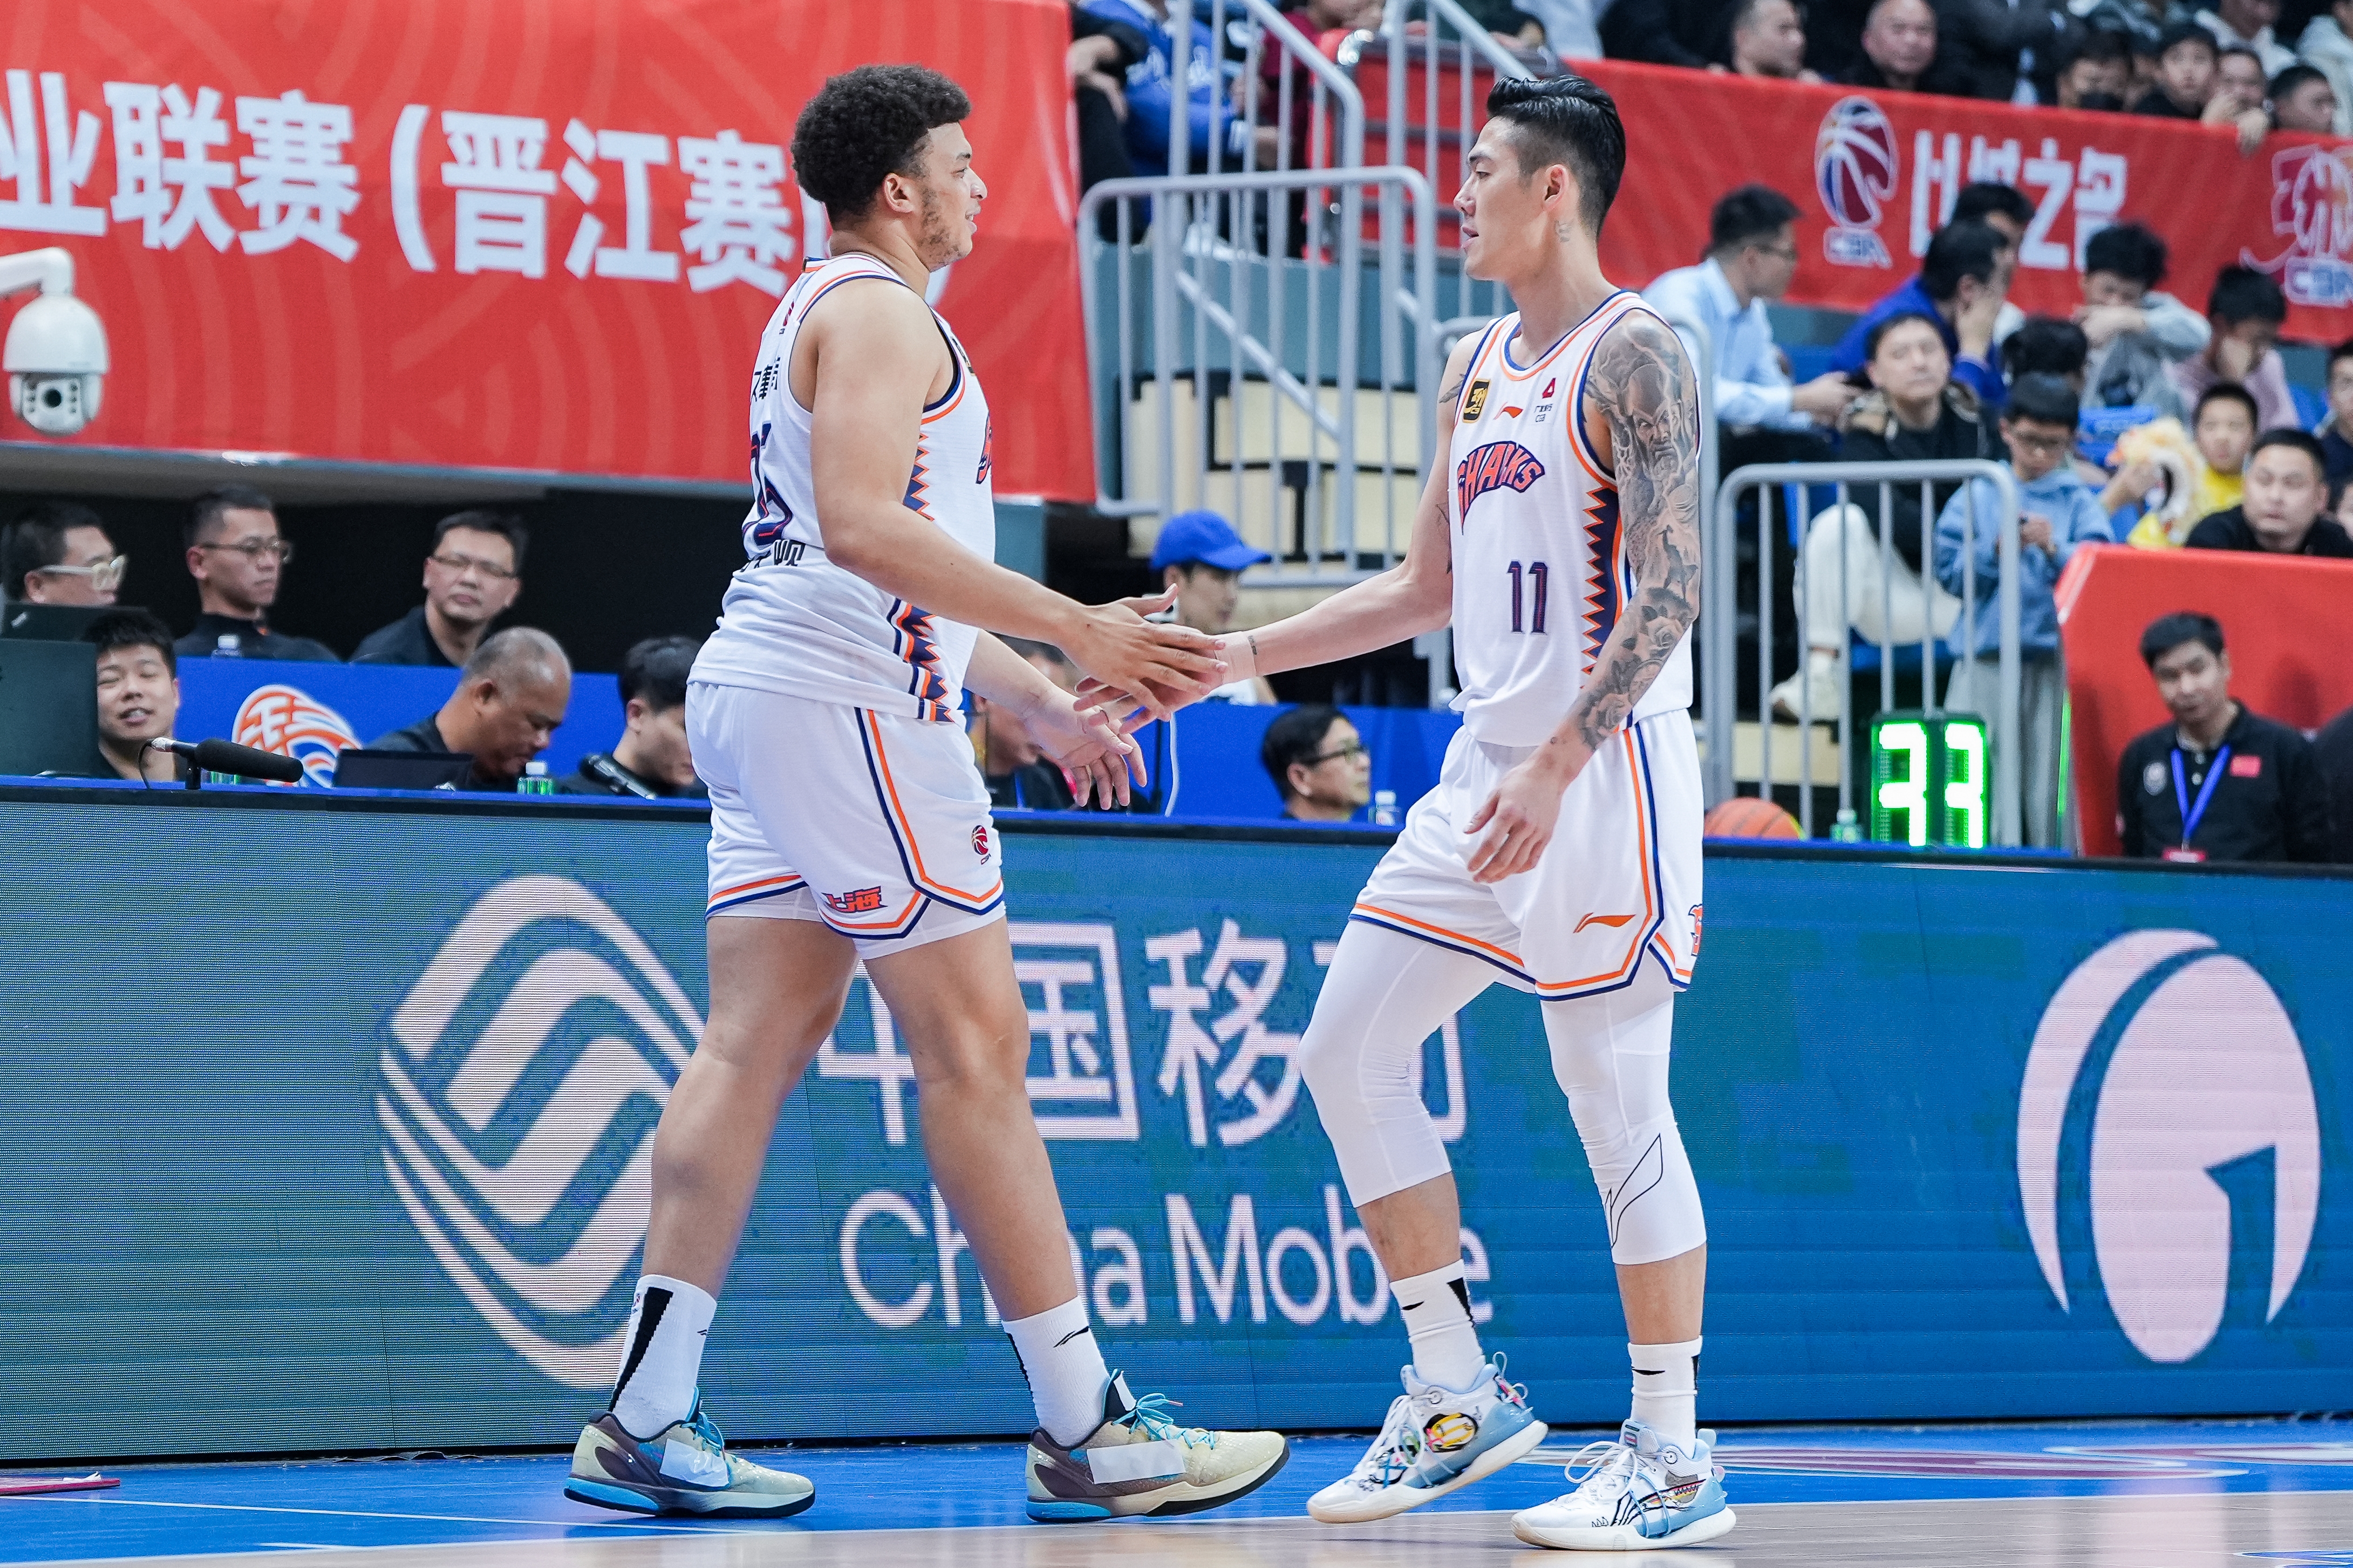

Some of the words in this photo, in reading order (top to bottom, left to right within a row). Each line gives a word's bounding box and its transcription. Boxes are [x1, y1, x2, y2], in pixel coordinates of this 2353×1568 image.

[1507, 561, 1547, 634] 11
[839, 1184, 1149, 1328] Cha
[1165, 1184, 1494, 1329] Mobe
